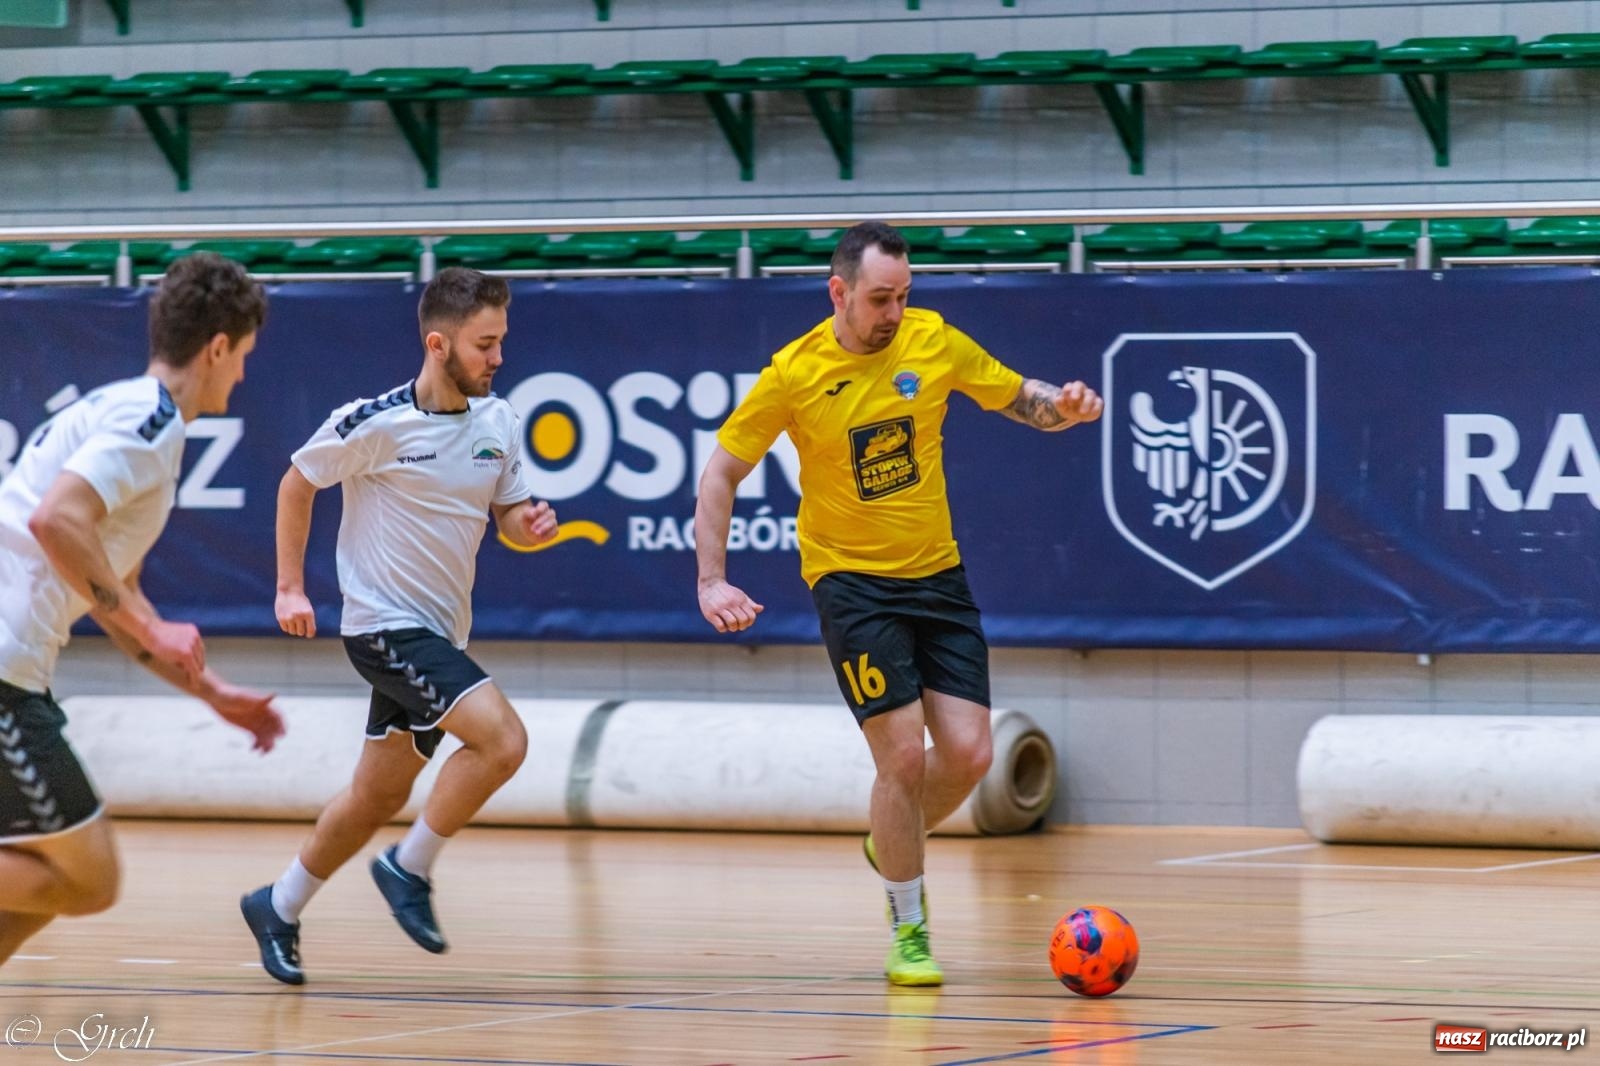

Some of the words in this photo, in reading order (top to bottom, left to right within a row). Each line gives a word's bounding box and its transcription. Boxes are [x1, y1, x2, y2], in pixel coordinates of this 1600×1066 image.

[863, 464, 913, 488] GARAGE
[1443, 413, 1600, 512] RA
[842, 652, 886, 705] 16
